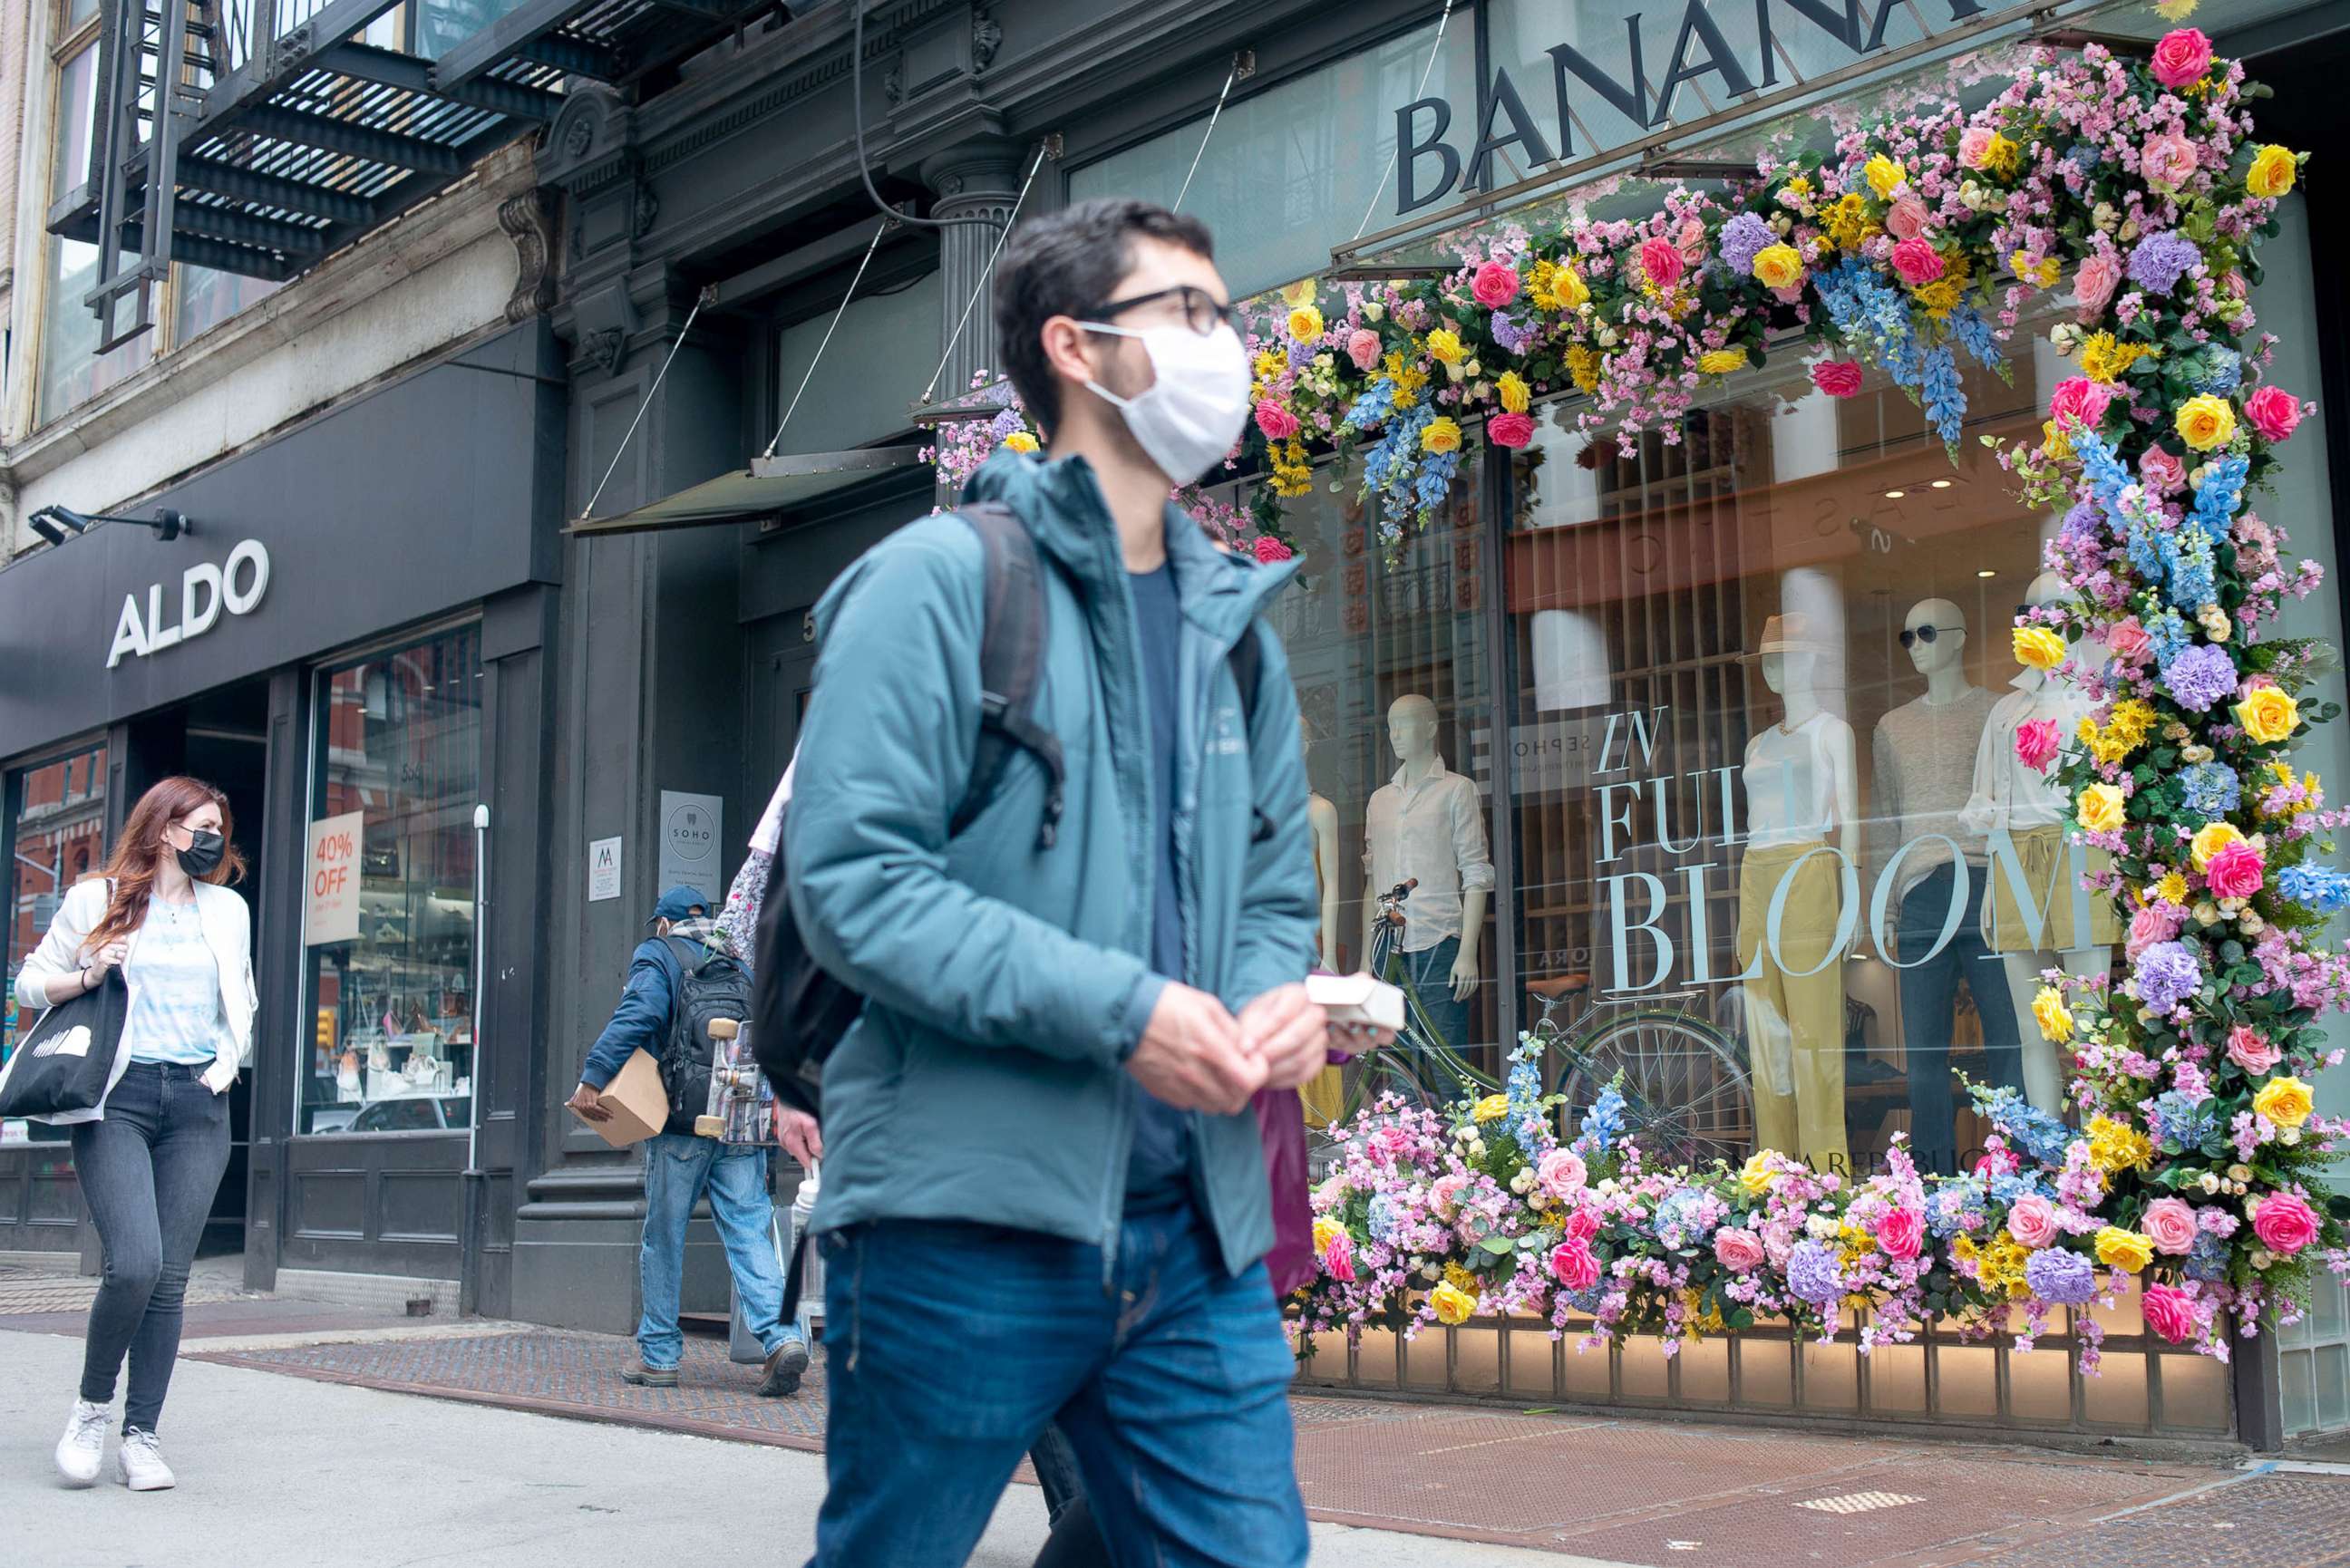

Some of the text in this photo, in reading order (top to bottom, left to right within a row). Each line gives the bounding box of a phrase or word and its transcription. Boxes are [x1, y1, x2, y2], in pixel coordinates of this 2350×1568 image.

[106, 538, 269, 668] ALDO
[1591, 705, 1669, 775] IN
[674, 828, 710, 840] SOHO
[1592, 765, 1833, 864] FULL
[316, 831, 353, 863] 40%
[314, 866, 348, 896] OFF
[1596, 827, 2111, 994] BLOOM
[1828, 1147, 1988, 1178] REPBLIC
